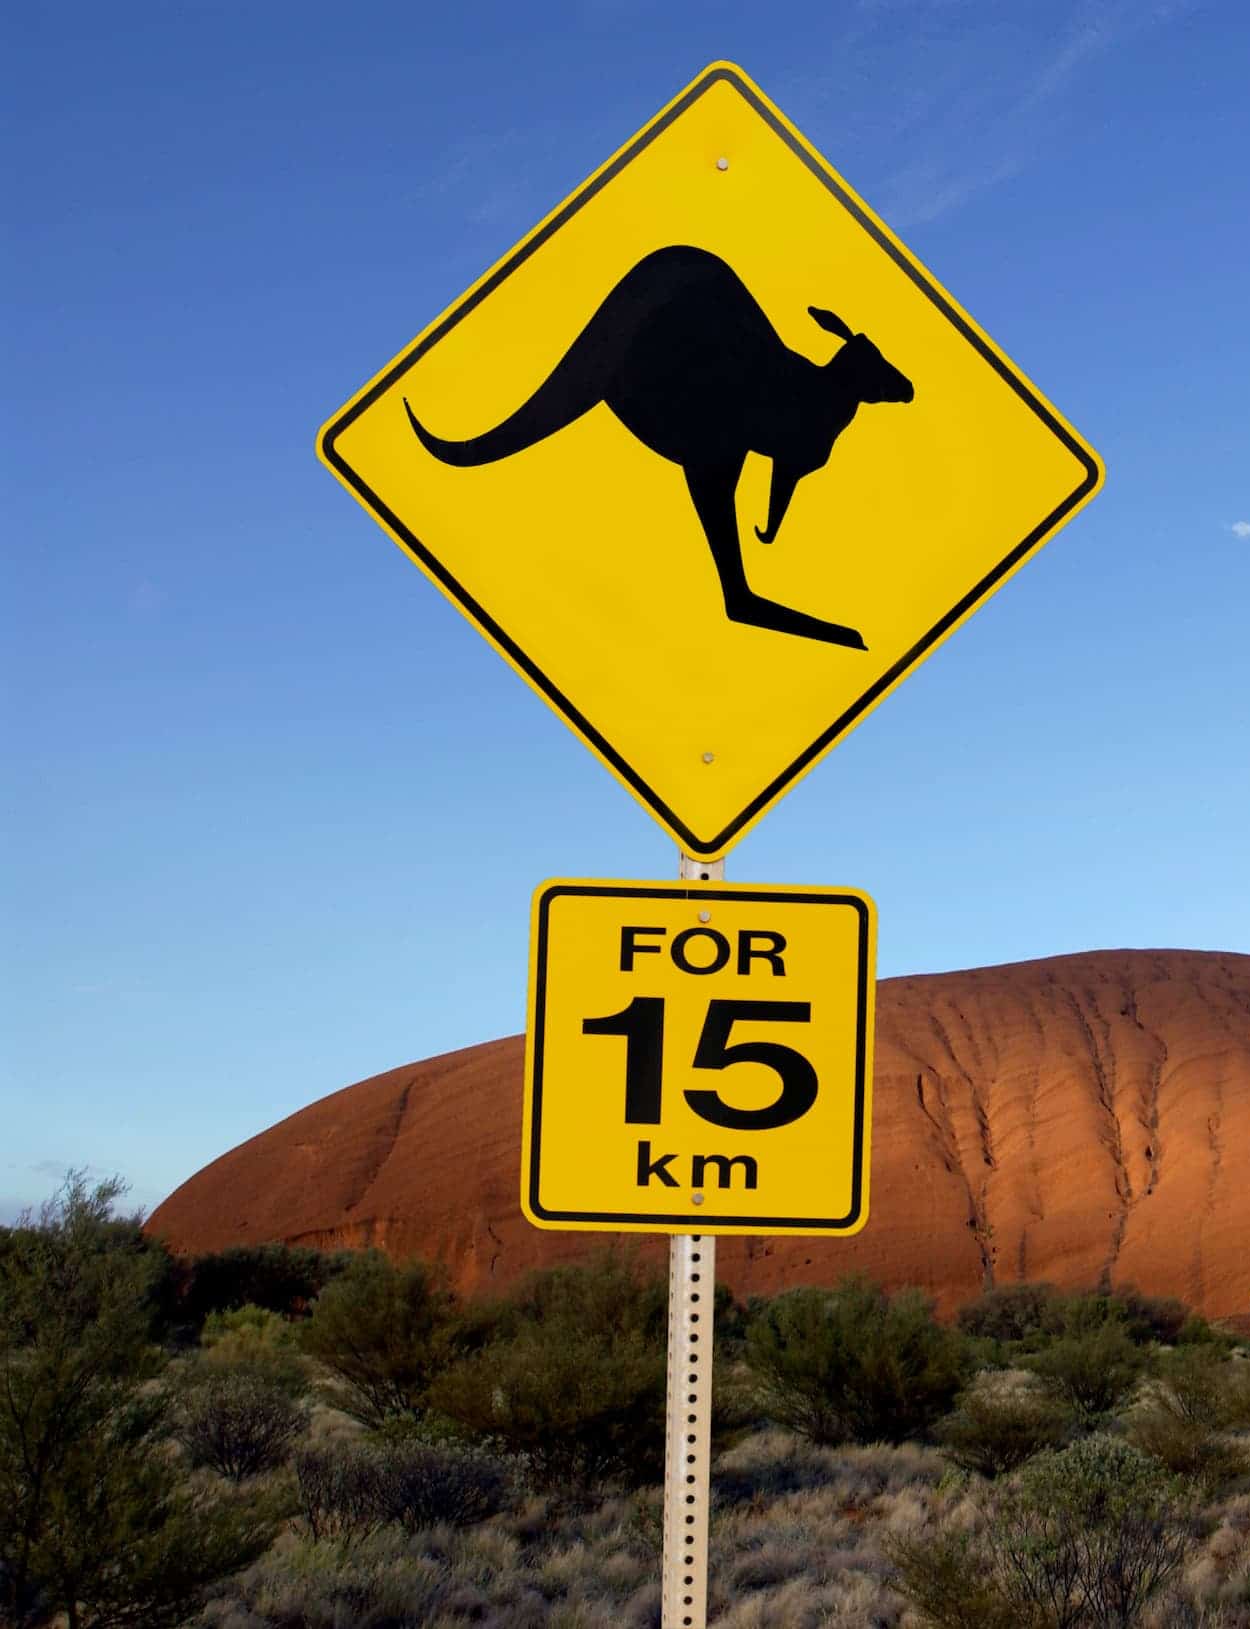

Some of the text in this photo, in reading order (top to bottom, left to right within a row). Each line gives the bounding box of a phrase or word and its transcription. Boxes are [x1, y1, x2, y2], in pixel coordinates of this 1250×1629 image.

[620, 926, 787, 977] FOR
[582, 996, 819, 1131] 15
[637, 1140, 758, 1190] km
